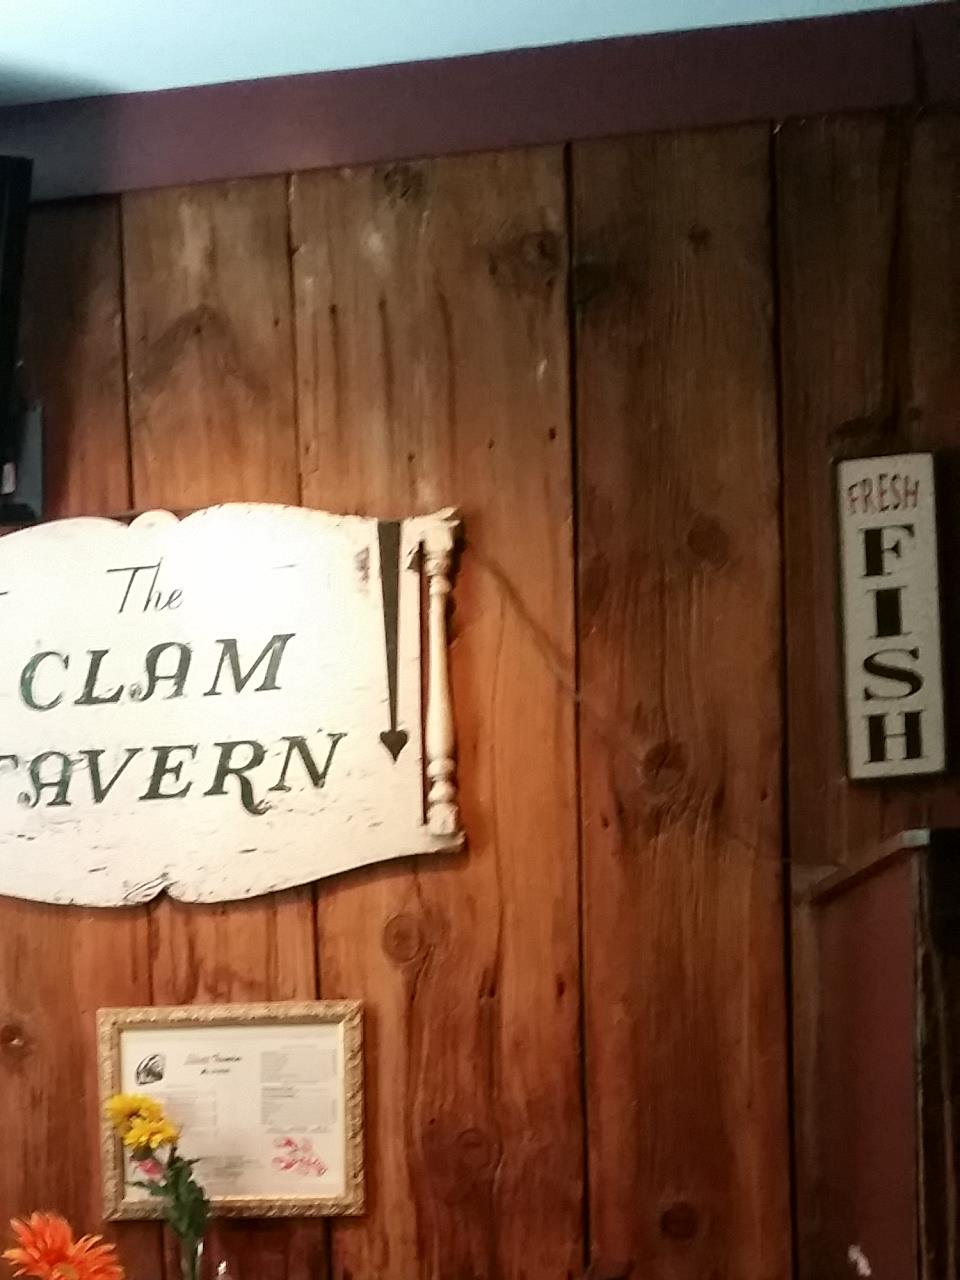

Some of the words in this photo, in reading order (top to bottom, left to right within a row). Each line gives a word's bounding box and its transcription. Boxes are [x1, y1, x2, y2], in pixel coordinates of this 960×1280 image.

[848, 473, 920, 514] FRESH
[106, 558, 184, 614] The
[20, 633, 296, 710] CLAM
[859, 523, 928, 764] FISH
